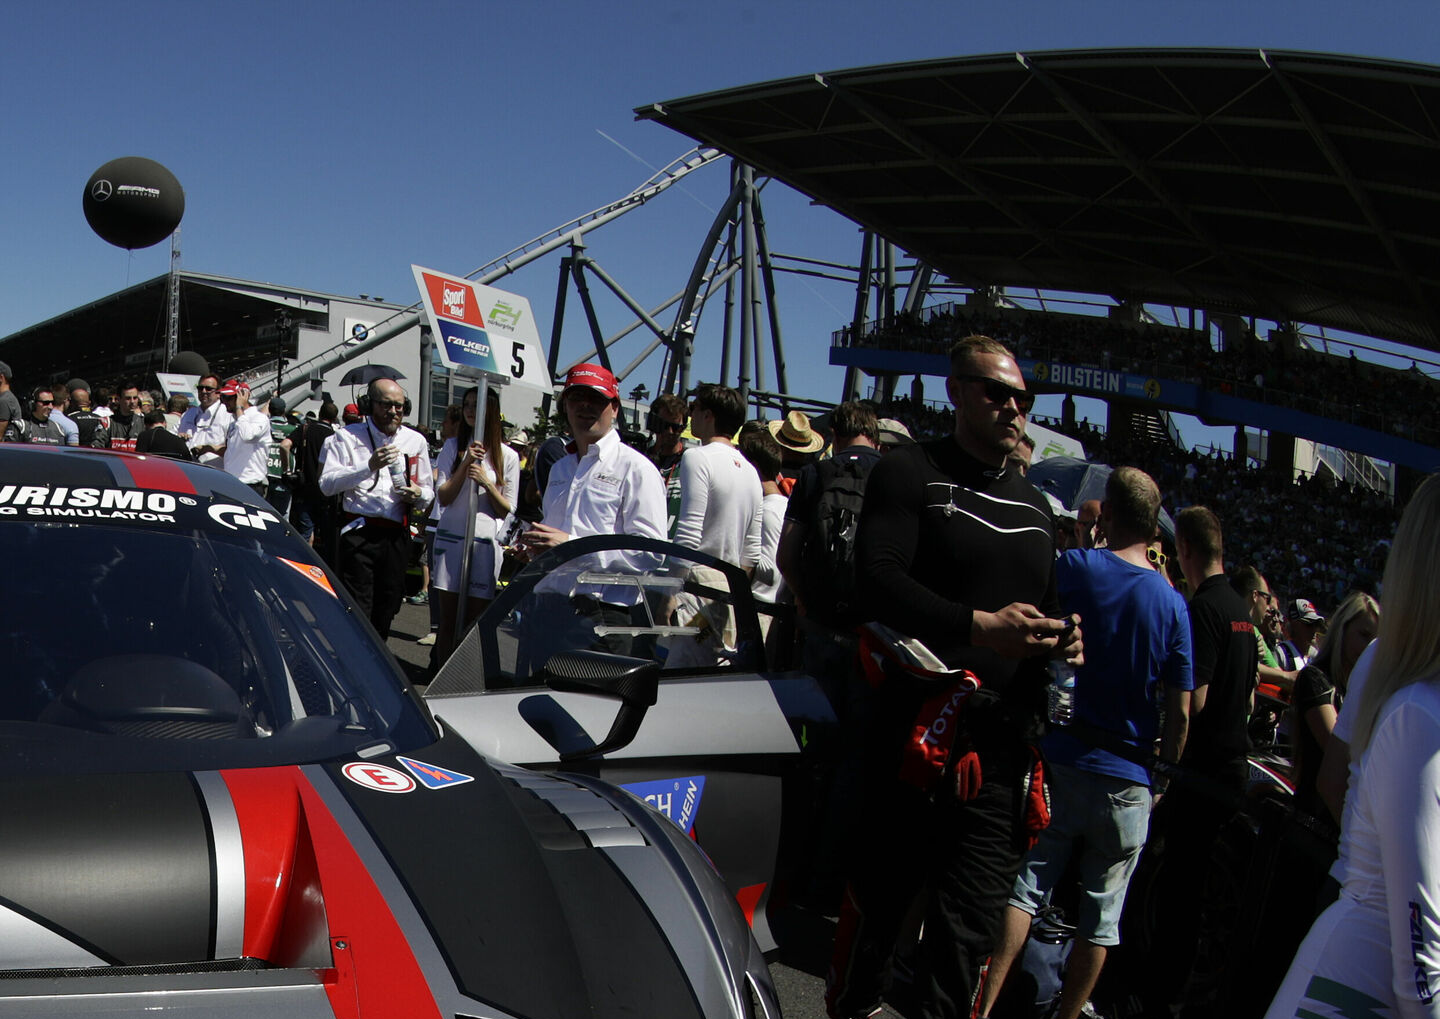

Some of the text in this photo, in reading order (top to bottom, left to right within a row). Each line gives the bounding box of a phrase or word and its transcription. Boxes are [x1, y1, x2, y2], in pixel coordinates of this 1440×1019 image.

[444, 288, 464, 307] Sport
[450, 304, 464, 318] Bild
[510, 341, 526, 379] 5
[1050, 364, 1120, 393] BILSTEIN
[27, 508, 176, 523] SIMULATOR
[919, 684, 976, 745] TOTAL
[361, 769, 398, 785] E
